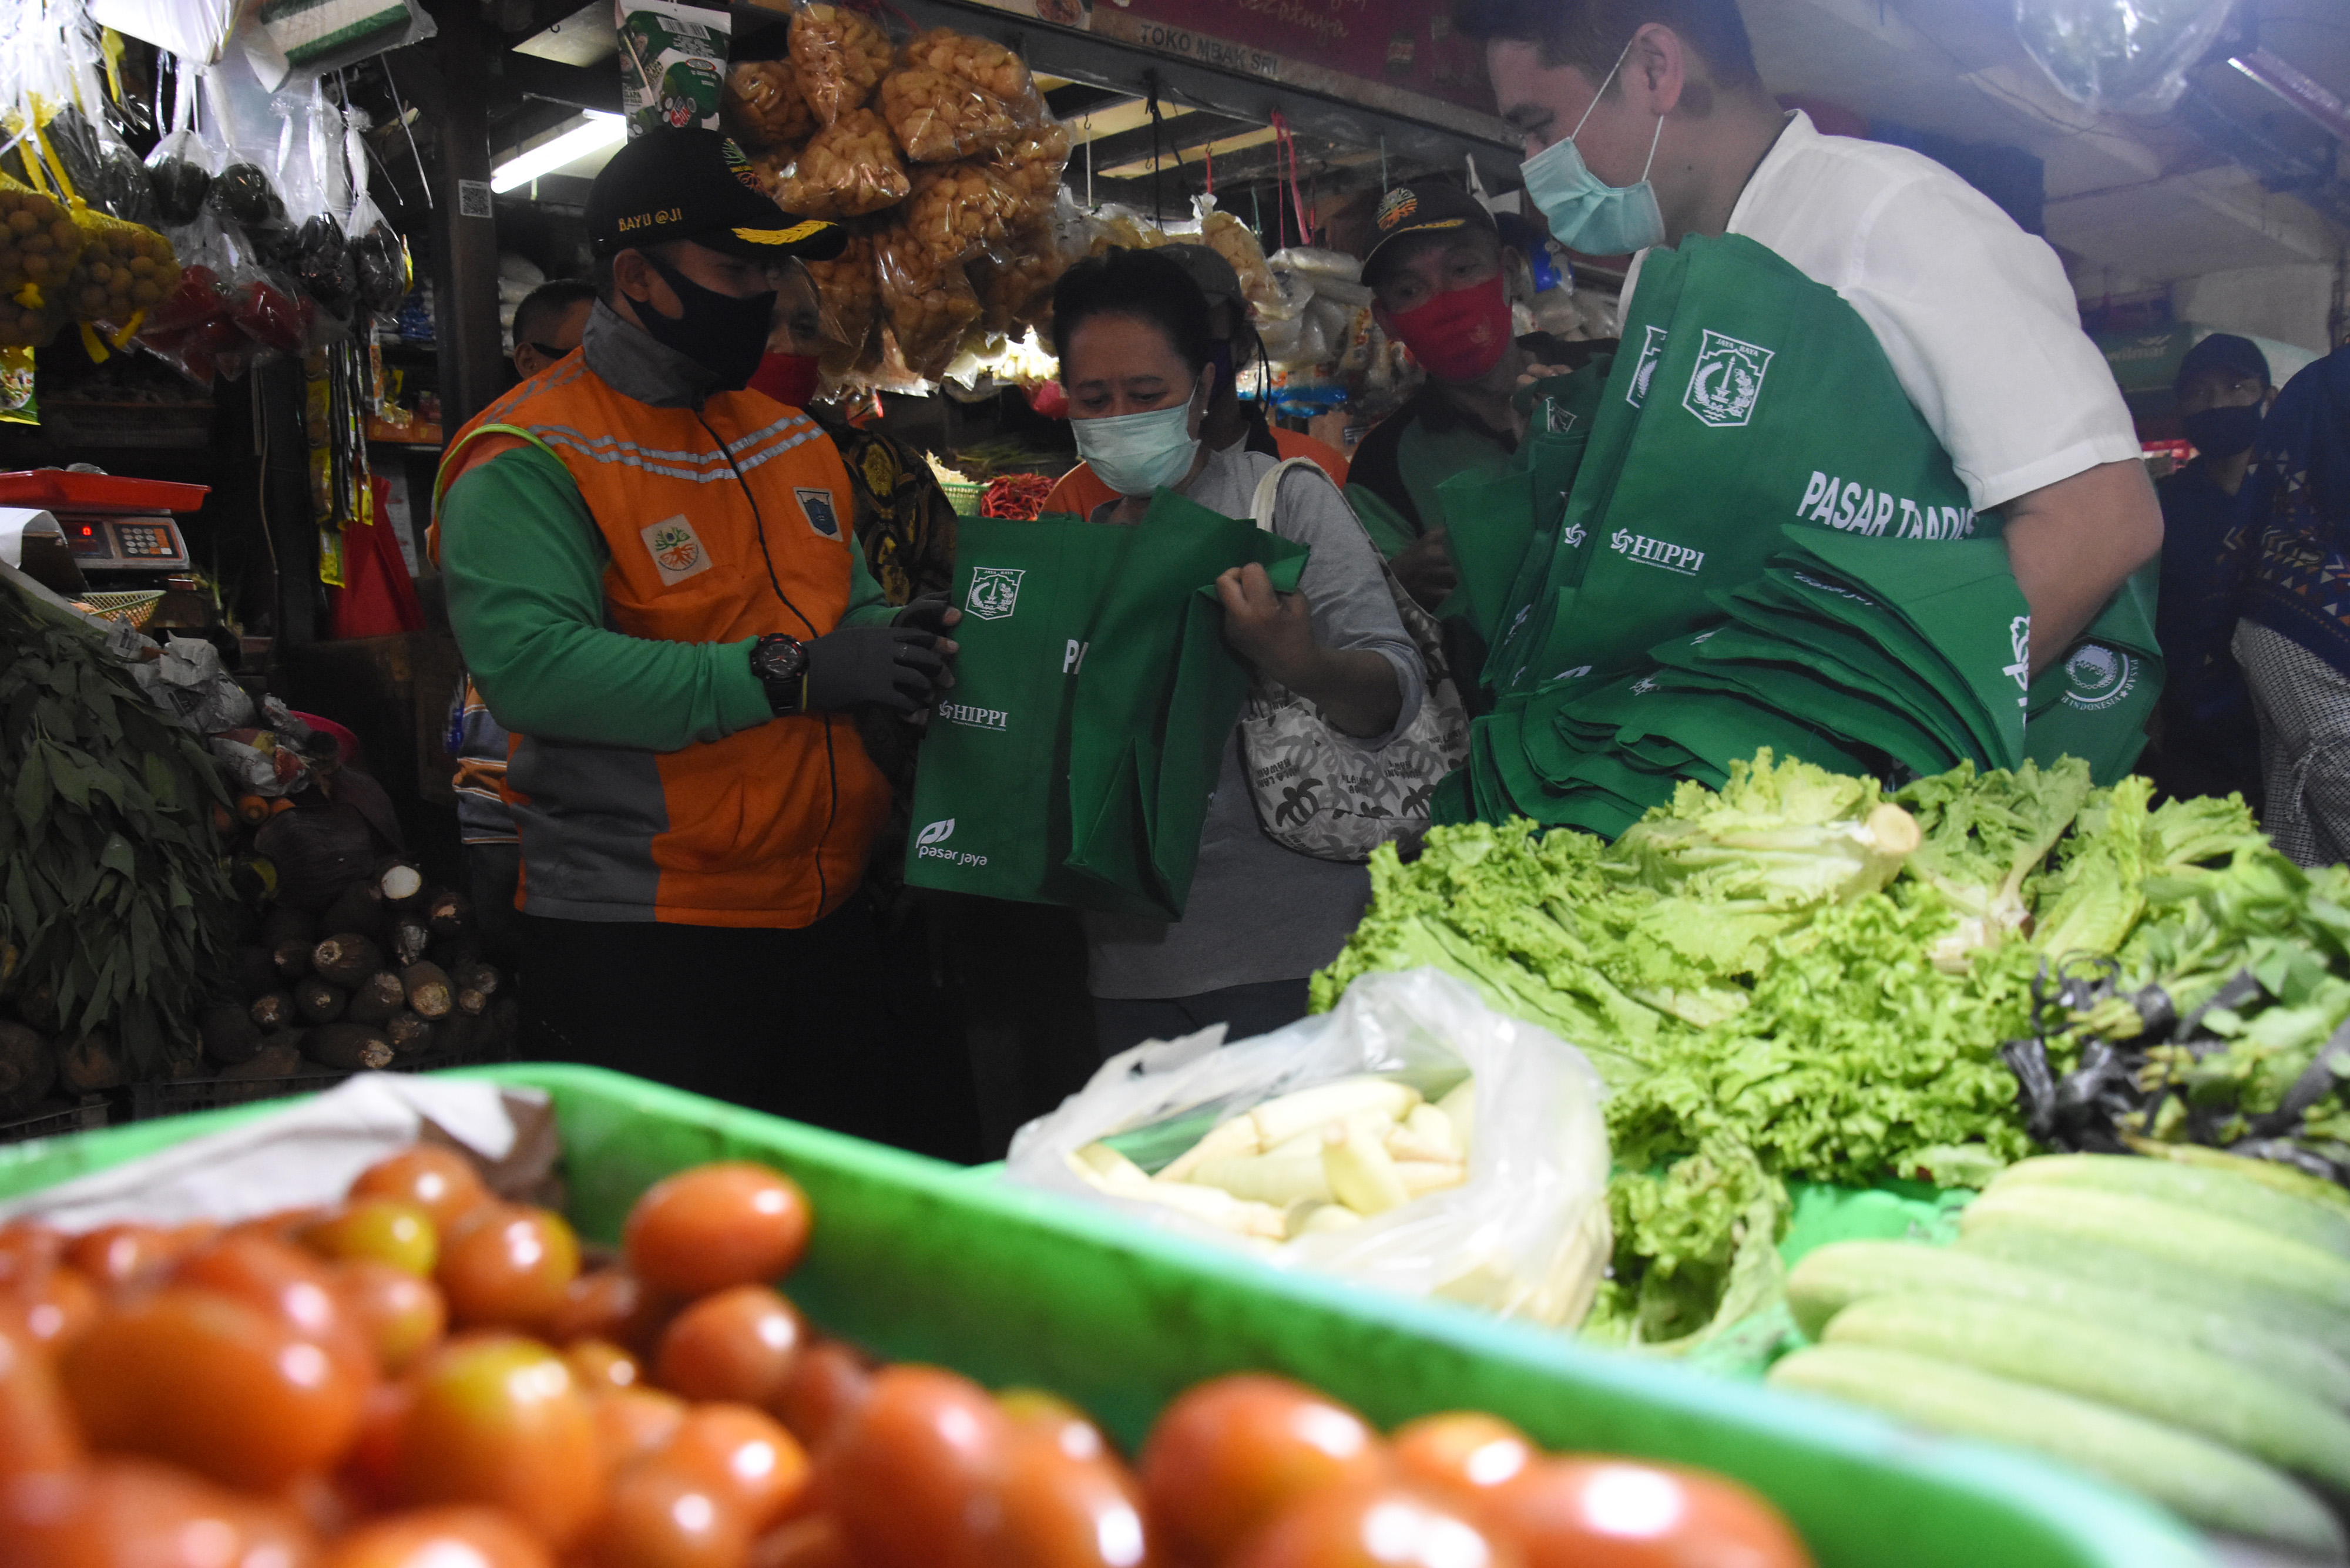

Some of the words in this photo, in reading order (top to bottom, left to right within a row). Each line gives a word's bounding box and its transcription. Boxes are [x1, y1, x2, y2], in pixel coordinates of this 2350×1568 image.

[1141, 23, 1191, 52] TOKO
[1197, 38, 1246, 66] MBAK
[1251, 53, 1278, 75] SRI
[617, 212, 652, 232] BAYU
[655, 207, 683, 224] @JI
[1715, 338, 1734, 350] JAYA
[1738, 345, 1759, 357] RAYA
[1795, 470, 1894, 537] PASAR
[1630, 535, 1706, 572] HIPPI
[2125, 659, 2138, 691] PASAR
[952, 704, 1009, 727] HIPPI
[2069, 695, 2121, 711] INDONESIA
[918, 845, 959, 861] pasar
[956, 852, 988, 867] jaya
